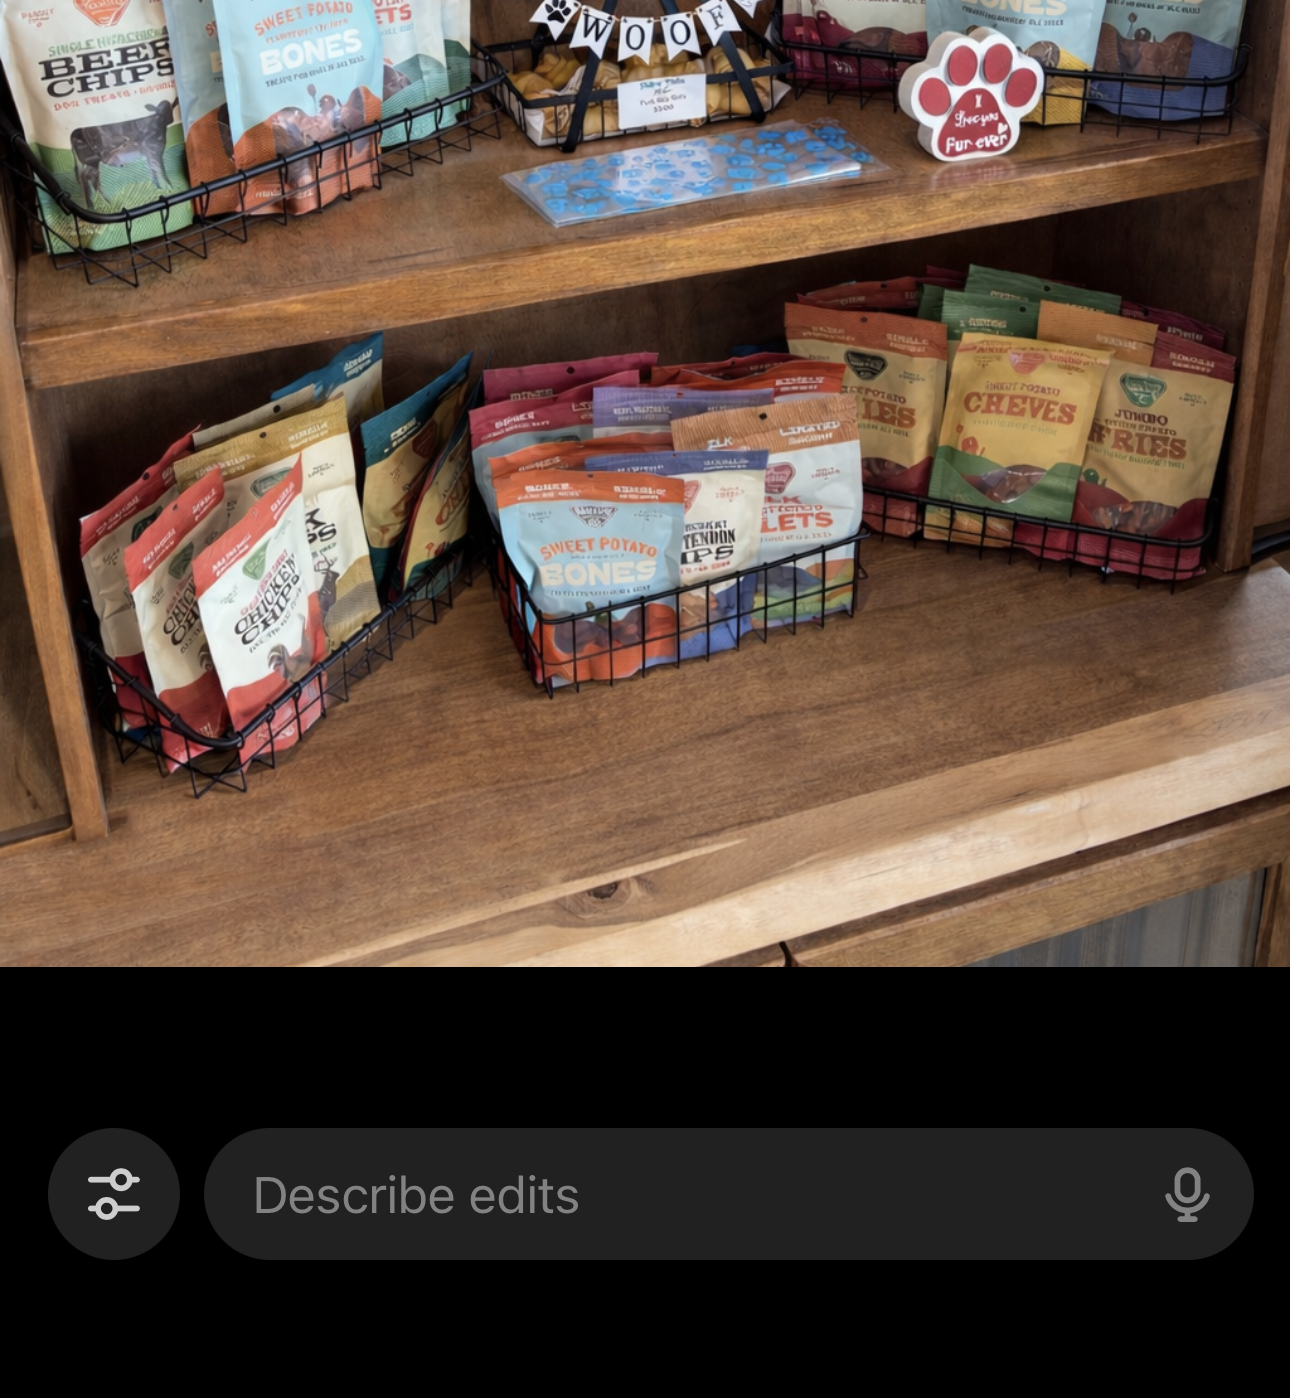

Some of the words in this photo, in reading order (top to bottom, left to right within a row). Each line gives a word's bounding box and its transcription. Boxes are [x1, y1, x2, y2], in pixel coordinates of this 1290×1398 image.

[258, 28, 363, 76] BONES
[539, 537, 595, 562] SWEET
[599, 536, 659, 559] POTATO
[539, 559, 658, 589] BONES
